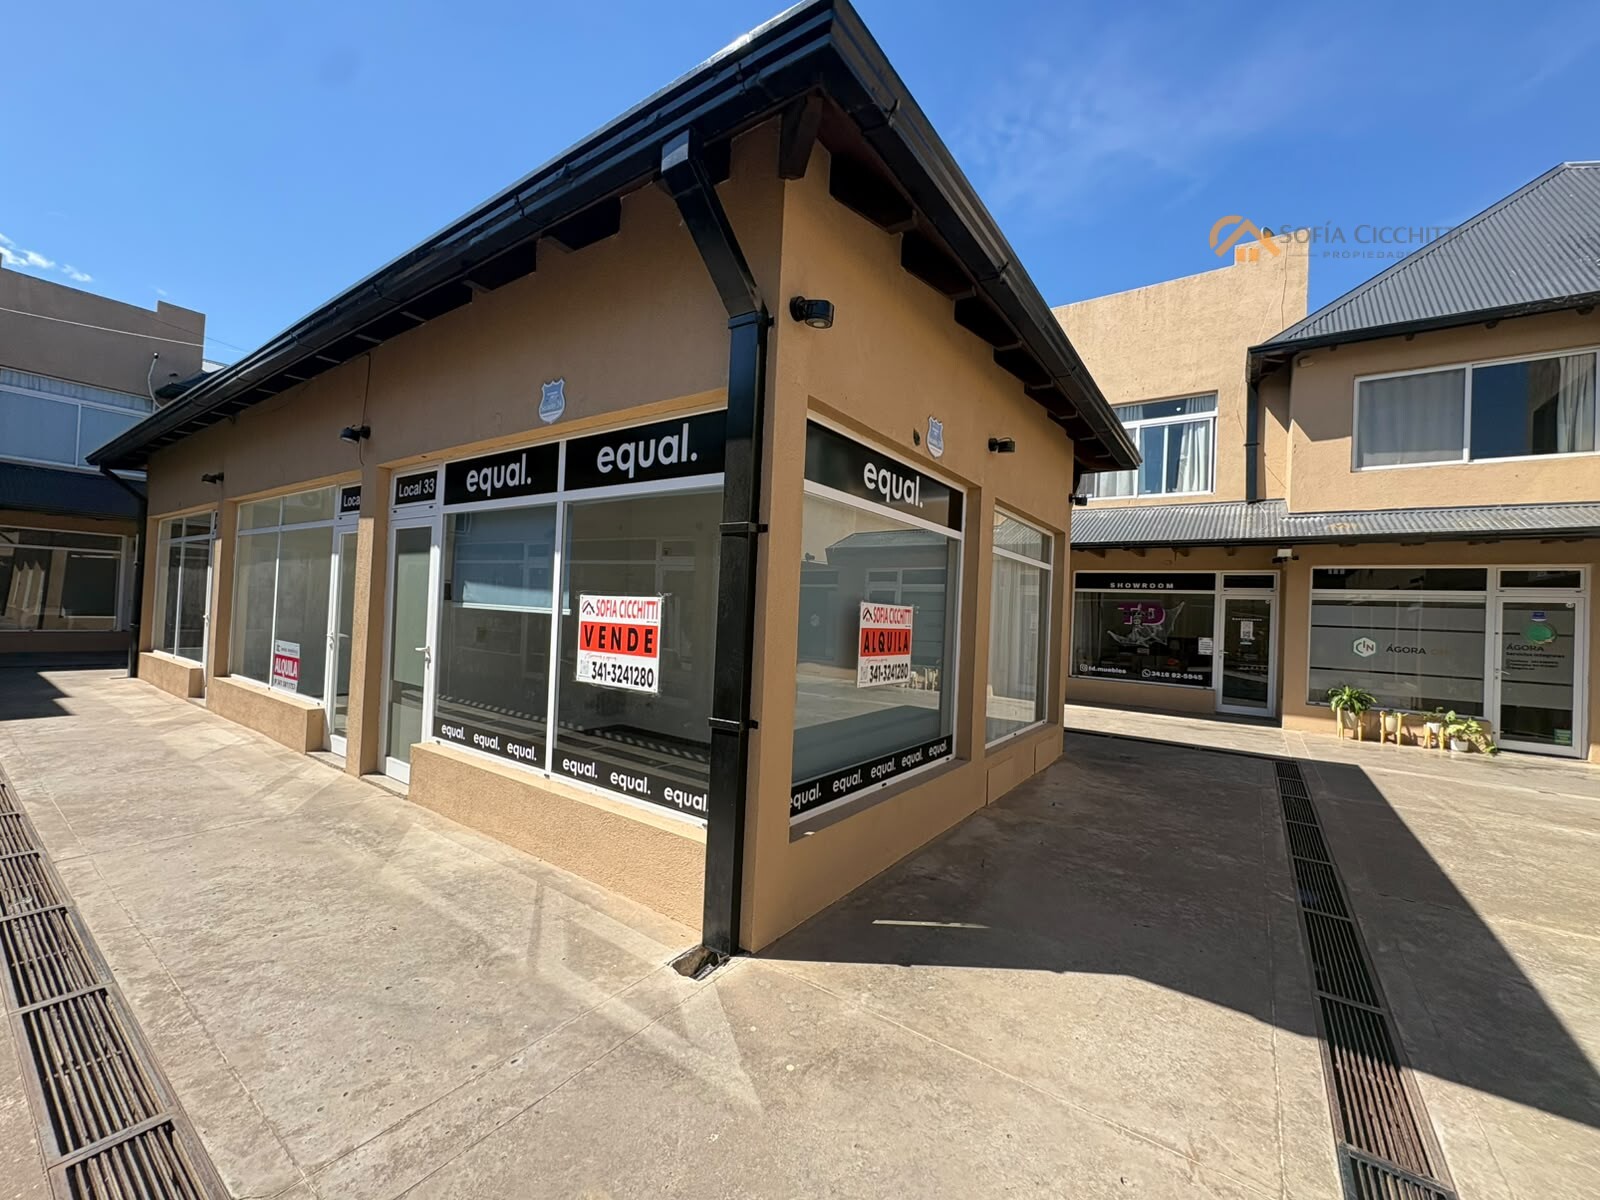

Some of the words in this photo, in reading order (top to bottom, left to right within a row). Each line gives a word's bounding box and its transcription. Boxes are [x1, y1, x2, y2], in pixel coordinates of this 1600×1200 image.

[597, 423, 698, 479] equal.
[399, 480, 423, 498] Local
[424, 478, 435, 494] 33
[466, 453, 532, 497] equal.
[863, 462, 924, 509] equal.
[343, 495, 361, 508] Loca
[619, 600, 659, 620] CICCHITTI
[584, 625, 653, 653] VENDE
[864, 632, 909, 653] ALQUILA
[1386, 643, 1426, 655] ÁGORA
[274, 658, 298, 678] ALQUILA
[591, 661, 654, 687] 341-3241280
[869, 663, 909, 683] 341-3241280
[441, 723, 466, 740] equal.
[473, 732, 500, 751] equal.
[507, 741, 537, 762] equal.
[562, 758, 598, 779] equal.
[610, 770, 651, 795] equal.
[832, 770, 863, 792] equal.
[870, 757, 896, 779] equal.
[901, 748, 923, 767] equal.
